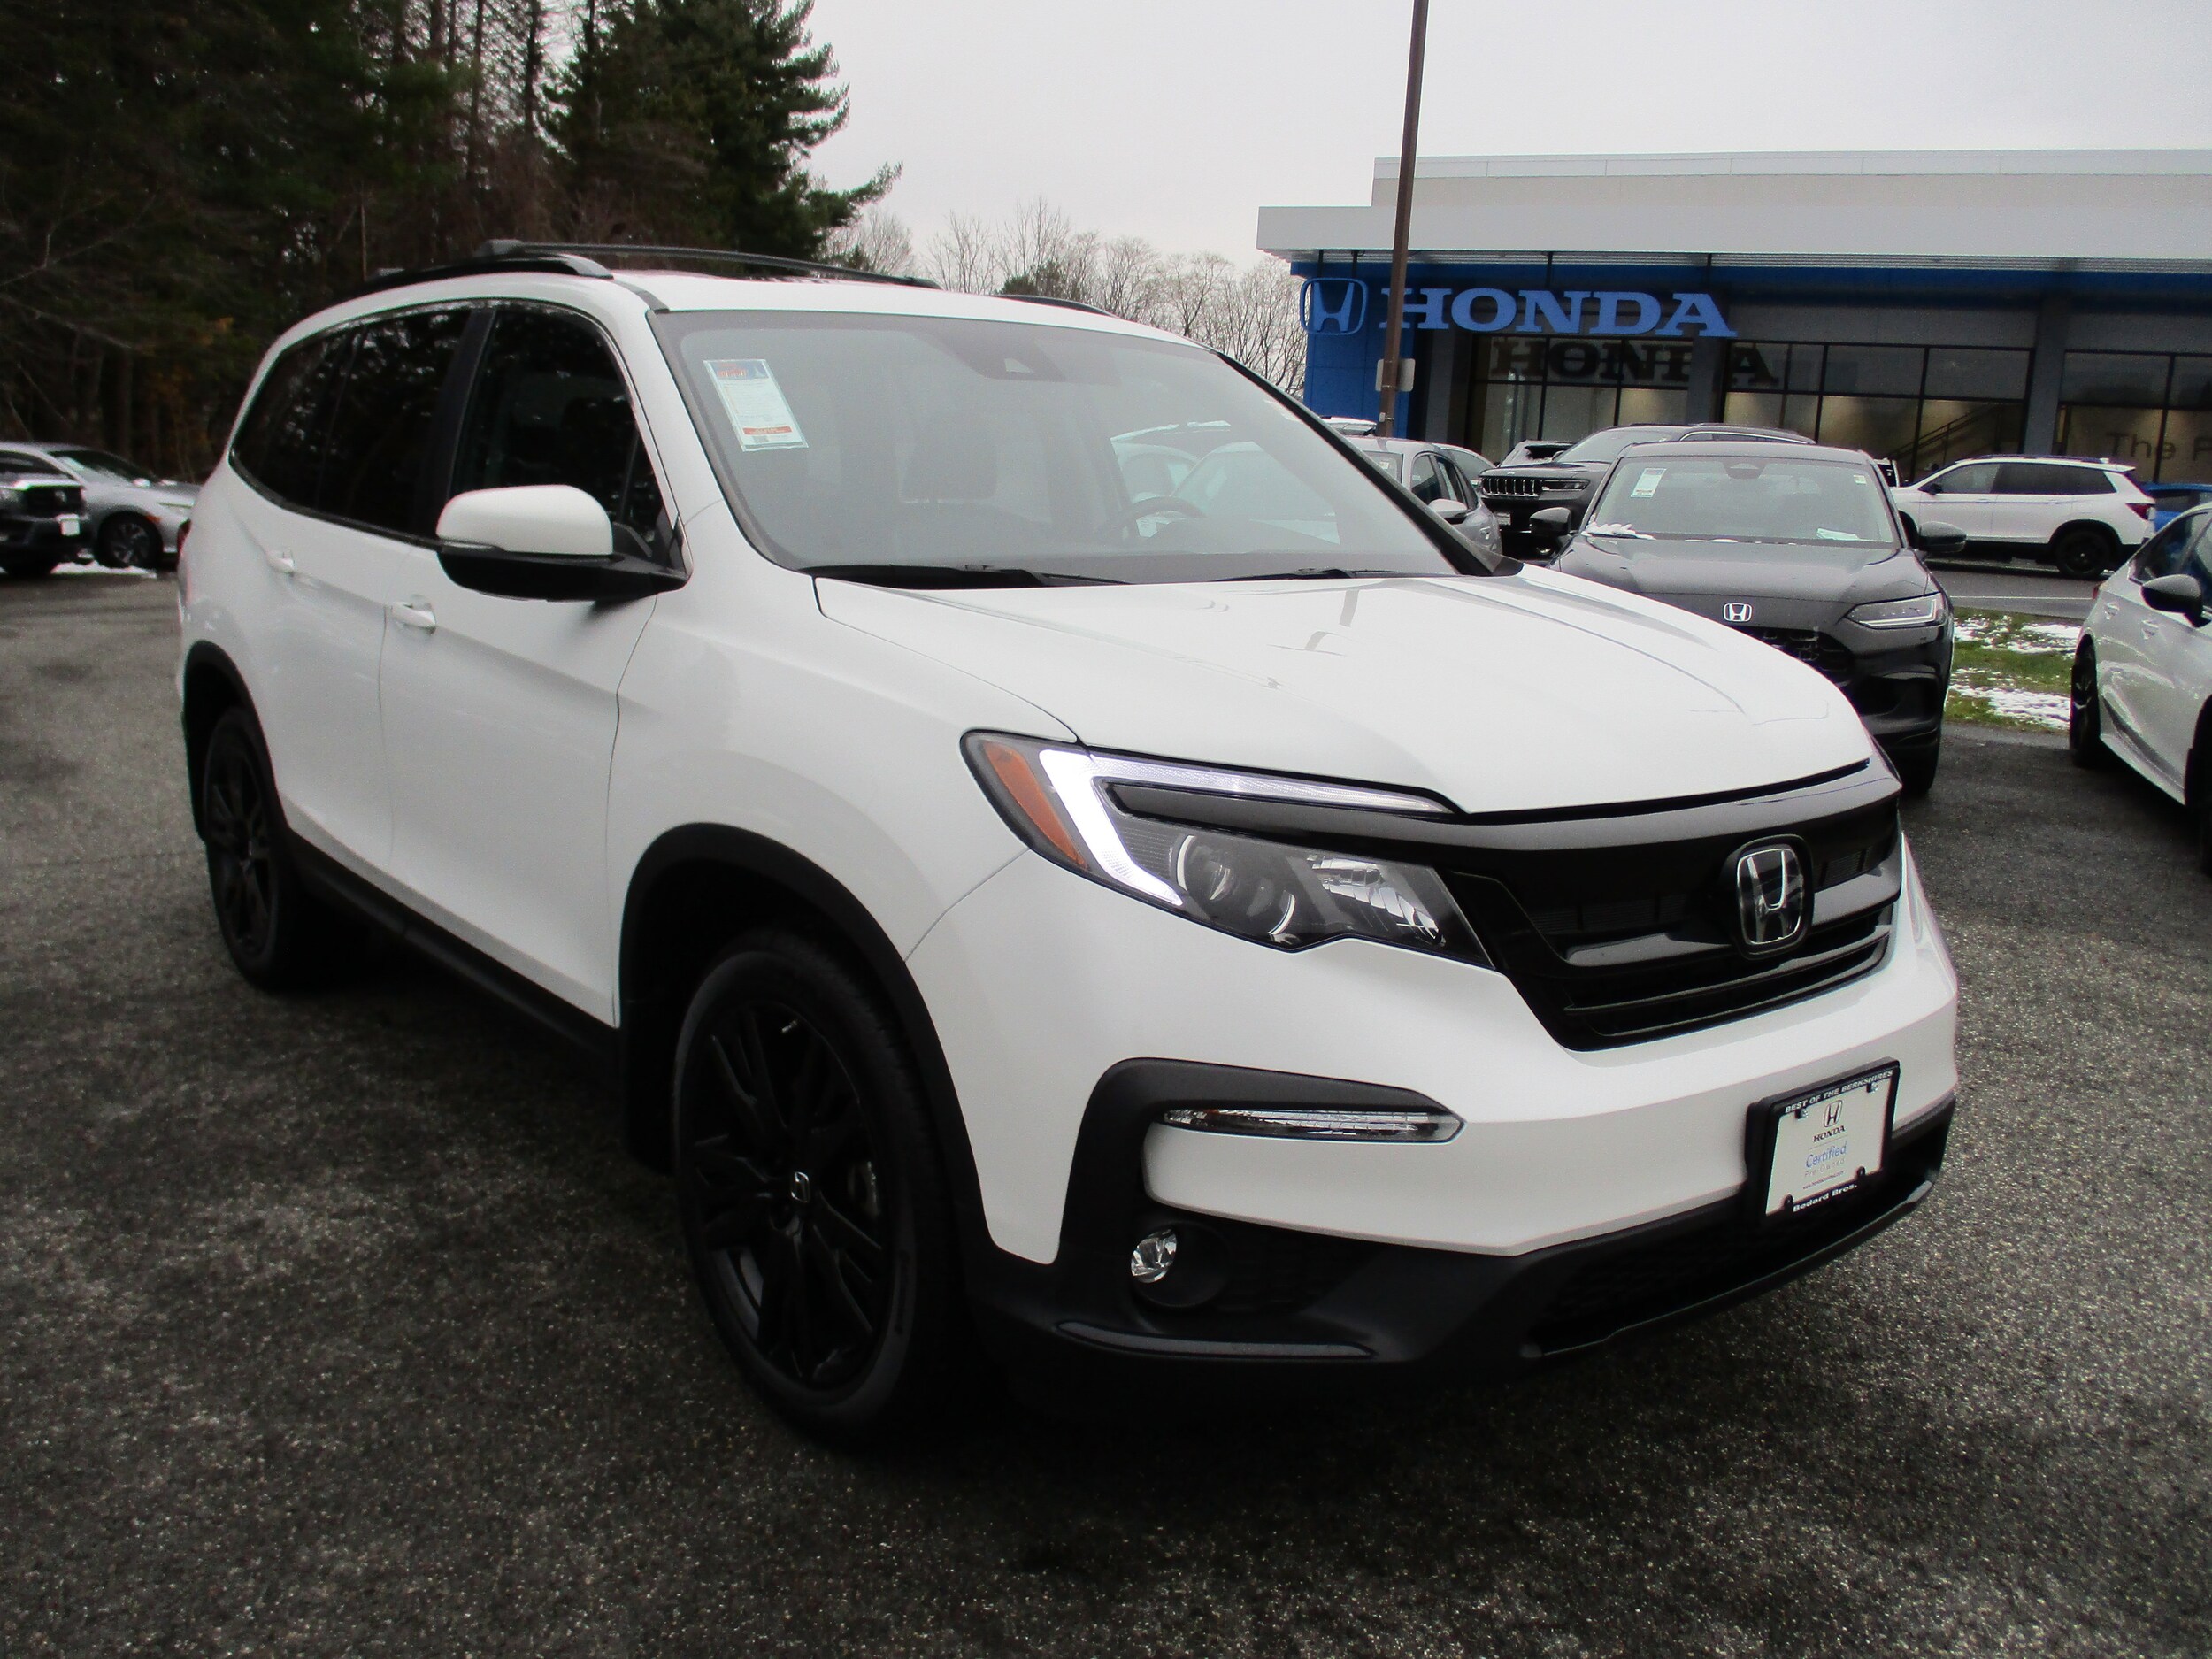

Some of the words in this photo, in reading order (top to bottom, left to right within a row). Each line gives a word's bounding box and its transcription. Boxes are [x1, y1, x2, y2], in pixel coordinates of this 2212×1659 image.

[1379, 287, 1738, 337] HONDA
[2107, 432, 2176, 460] The
[1785, 1099, 1808, 1113] BEST
[1809, 1095, 1821, 1104] OF
[1823, 1087, 1839, 1099] THE
[1841, 1070, 1893, 1093] BERKSHIRES
[1813, 1125, 1845, 1142] HONDA
[1806, 1141, 1847, 1168] Certified
[1793, 1193, 1830, 1212] Bedard
[1832, 1184, 1857, 1196] Bros.
